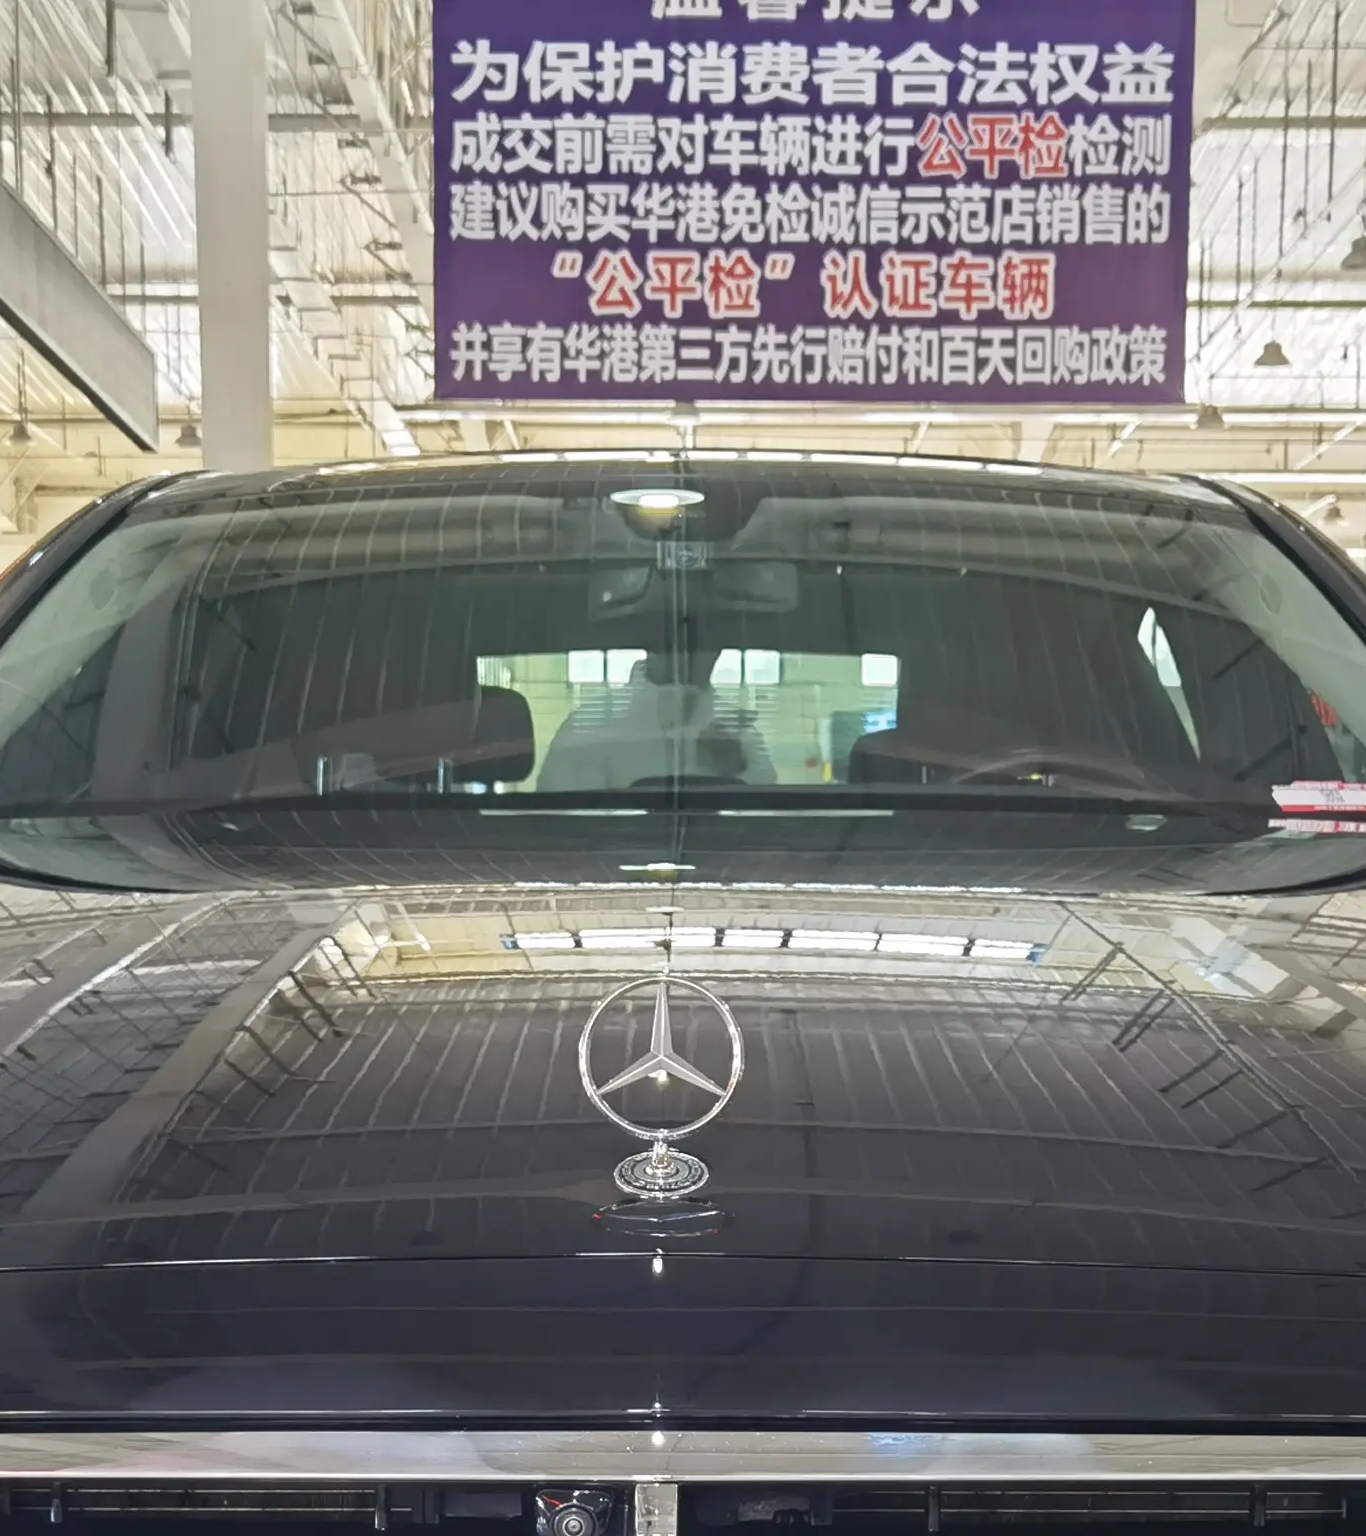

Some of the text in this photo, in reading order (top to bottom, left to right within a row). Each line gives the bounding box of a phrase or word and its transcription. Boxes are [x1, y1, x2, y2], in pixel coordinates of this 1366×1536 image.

[450, 38, 1175, 105] 为保护消费者合法权益
[450, 111, 1172, 179] 成交前需对车辆进行公平检检测
[449, 180, 1172, 244] 建议购买华港免检诚信示范店销售的
[450, 320, 1167, 385] 并享有华港第三方先行赔付和百天回购政策
